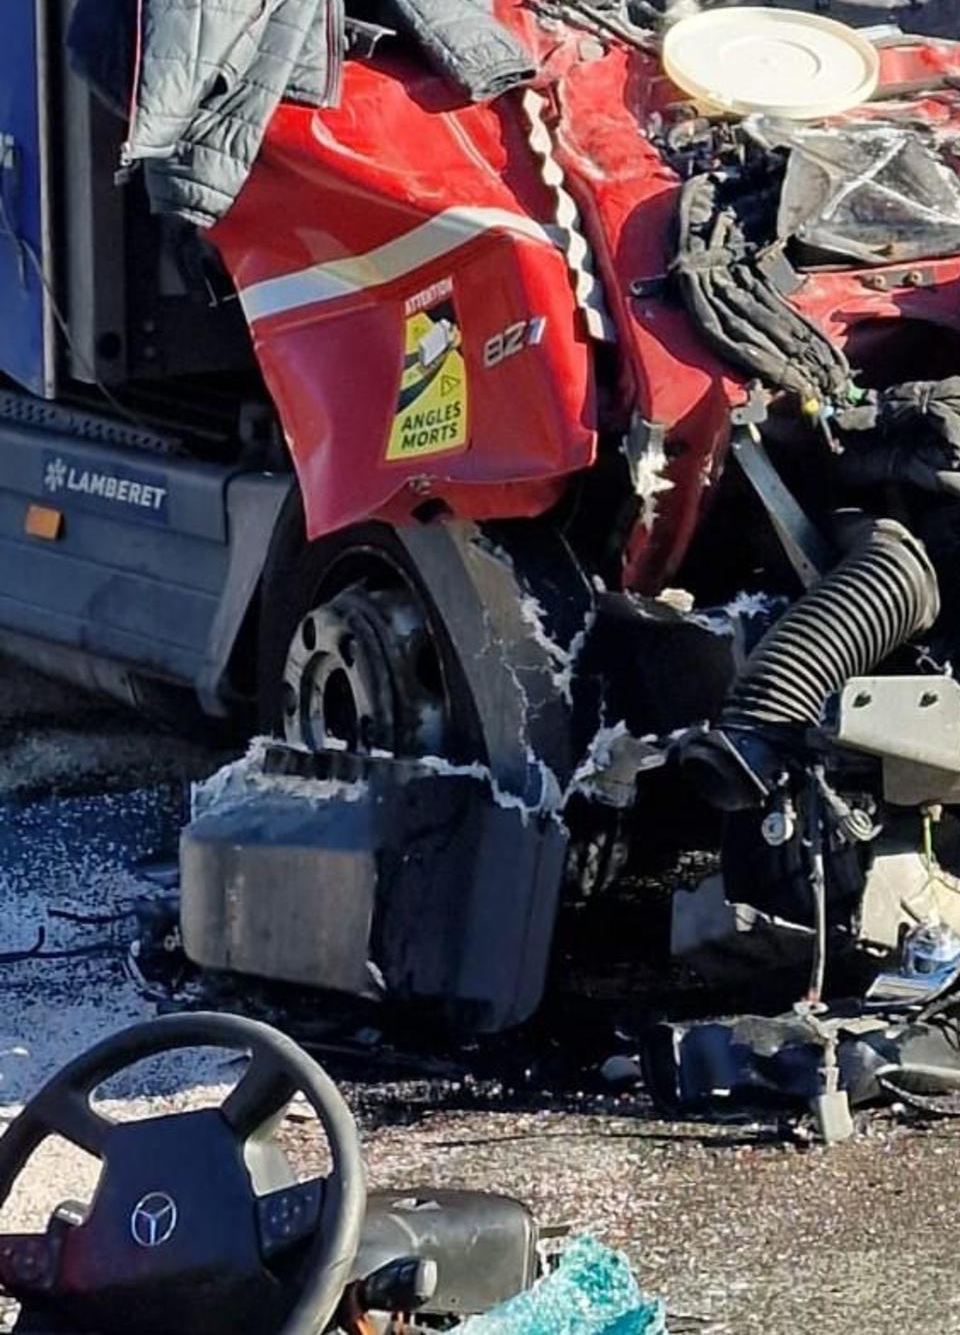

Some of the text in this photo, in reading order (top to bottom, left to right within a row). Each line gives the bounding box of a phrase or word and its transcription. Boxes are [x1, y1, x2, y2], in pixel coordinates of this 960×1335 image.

[401, 400, 461, 432] ANGLES
[402, 422, 457, 449] MORTS
[67, 468, 166, 509] LAMBERET
